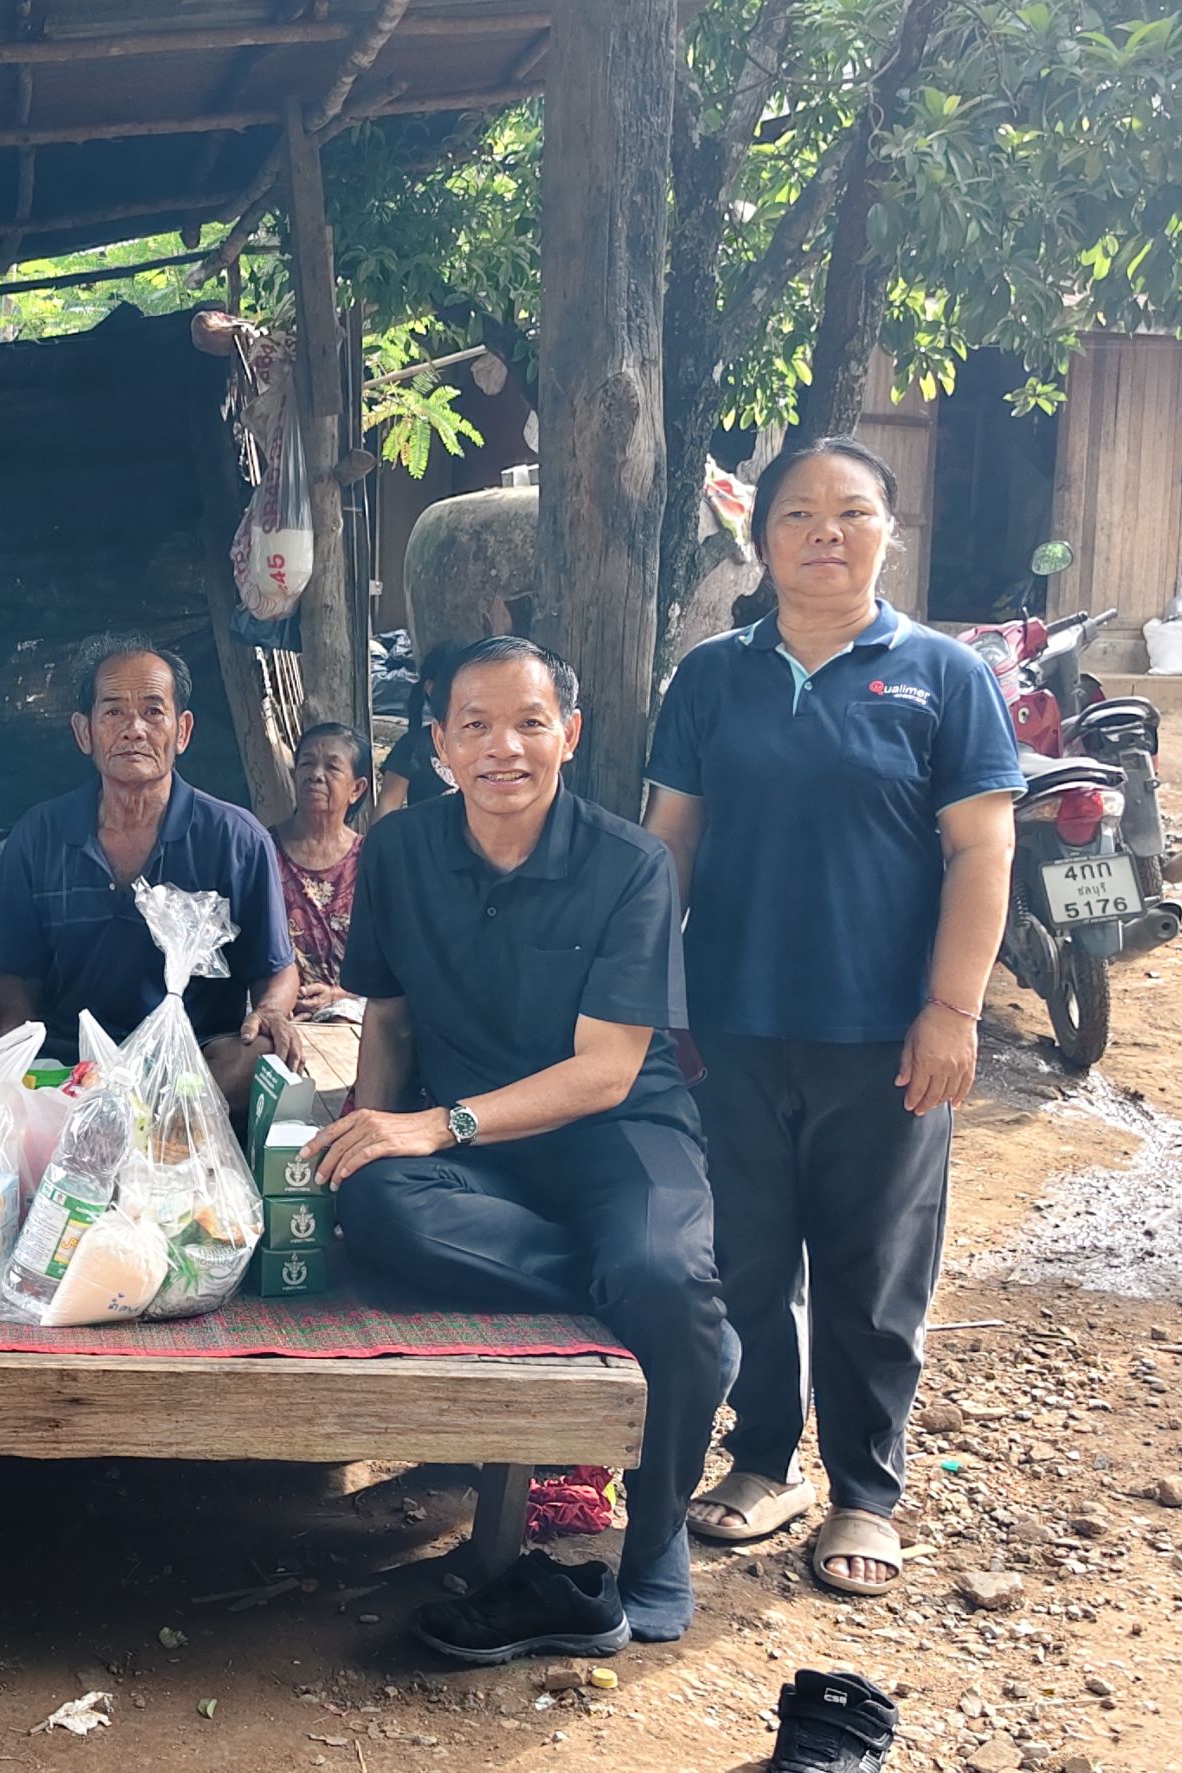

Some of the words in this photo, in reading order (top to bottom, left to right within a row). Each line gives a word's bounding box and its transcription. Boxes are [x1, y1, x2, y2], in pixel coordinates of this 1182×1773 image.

[868, 680, 931, 700] Qualimer
[1064, 862, 1113, 881] 4กก
[1077, 882, 1107, 897] ชลบุรี
[1064, 897, 1129, 919] 5176
